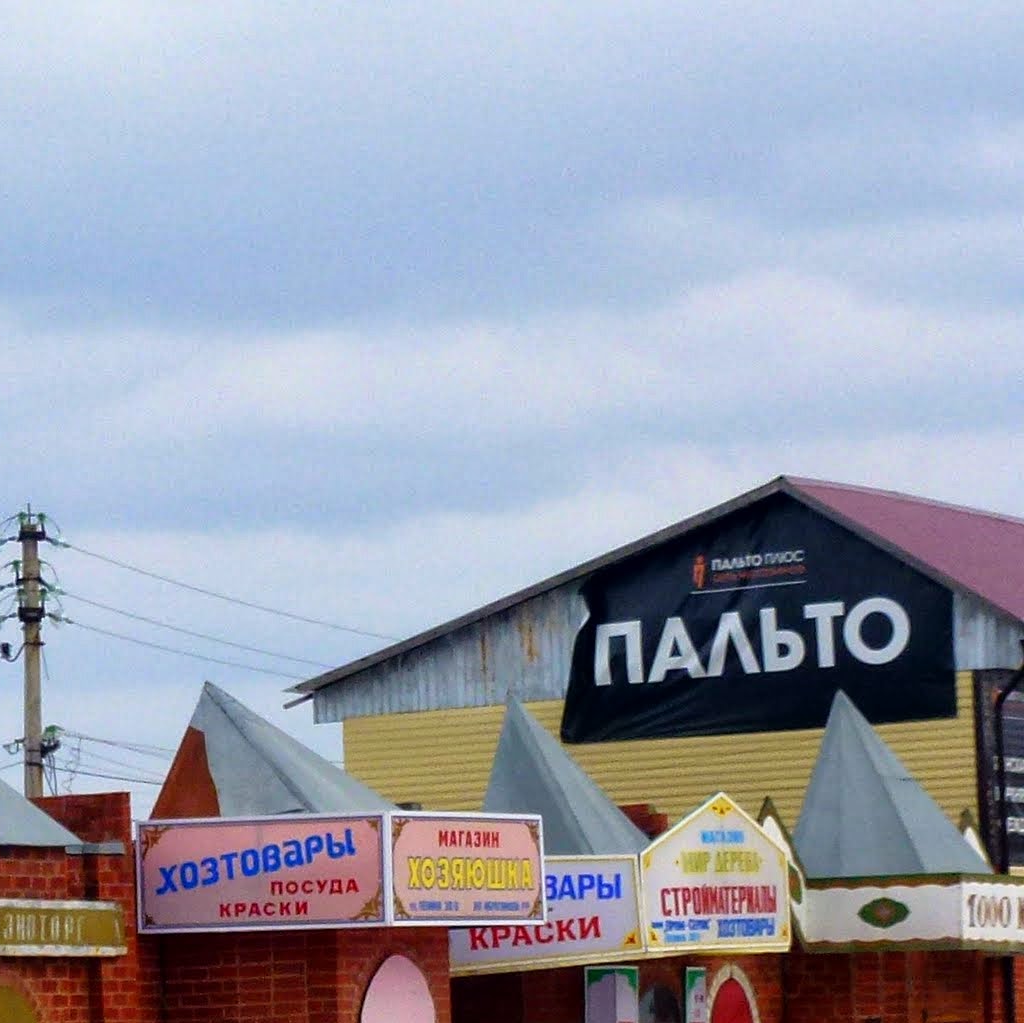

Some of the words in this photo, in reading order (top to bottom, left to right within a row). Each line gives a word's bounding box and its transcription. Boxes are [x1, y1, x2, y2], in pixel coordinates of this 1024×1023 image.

[711, 554, 763, 571] ПАЛЬТО
[594, 597, 911, 686] ПАЛЬТО
[438, 830, 500, 848] МАГАЗИН
[156, 828, 356, 896] ХОЗТОВАРЫ
[407, 856, 534, 890] ХОЗЯЮШКА
[271, 878, 360, 896] ПОСУДА
[660, 884, 777, 917] СТРОЙМАТЕРИАЛЫ
[219, 900, 309, 918] КРАСКИ
[967, 893, 1012, 929] 1000
[469, 916, 602, 950] КРАСКИ
